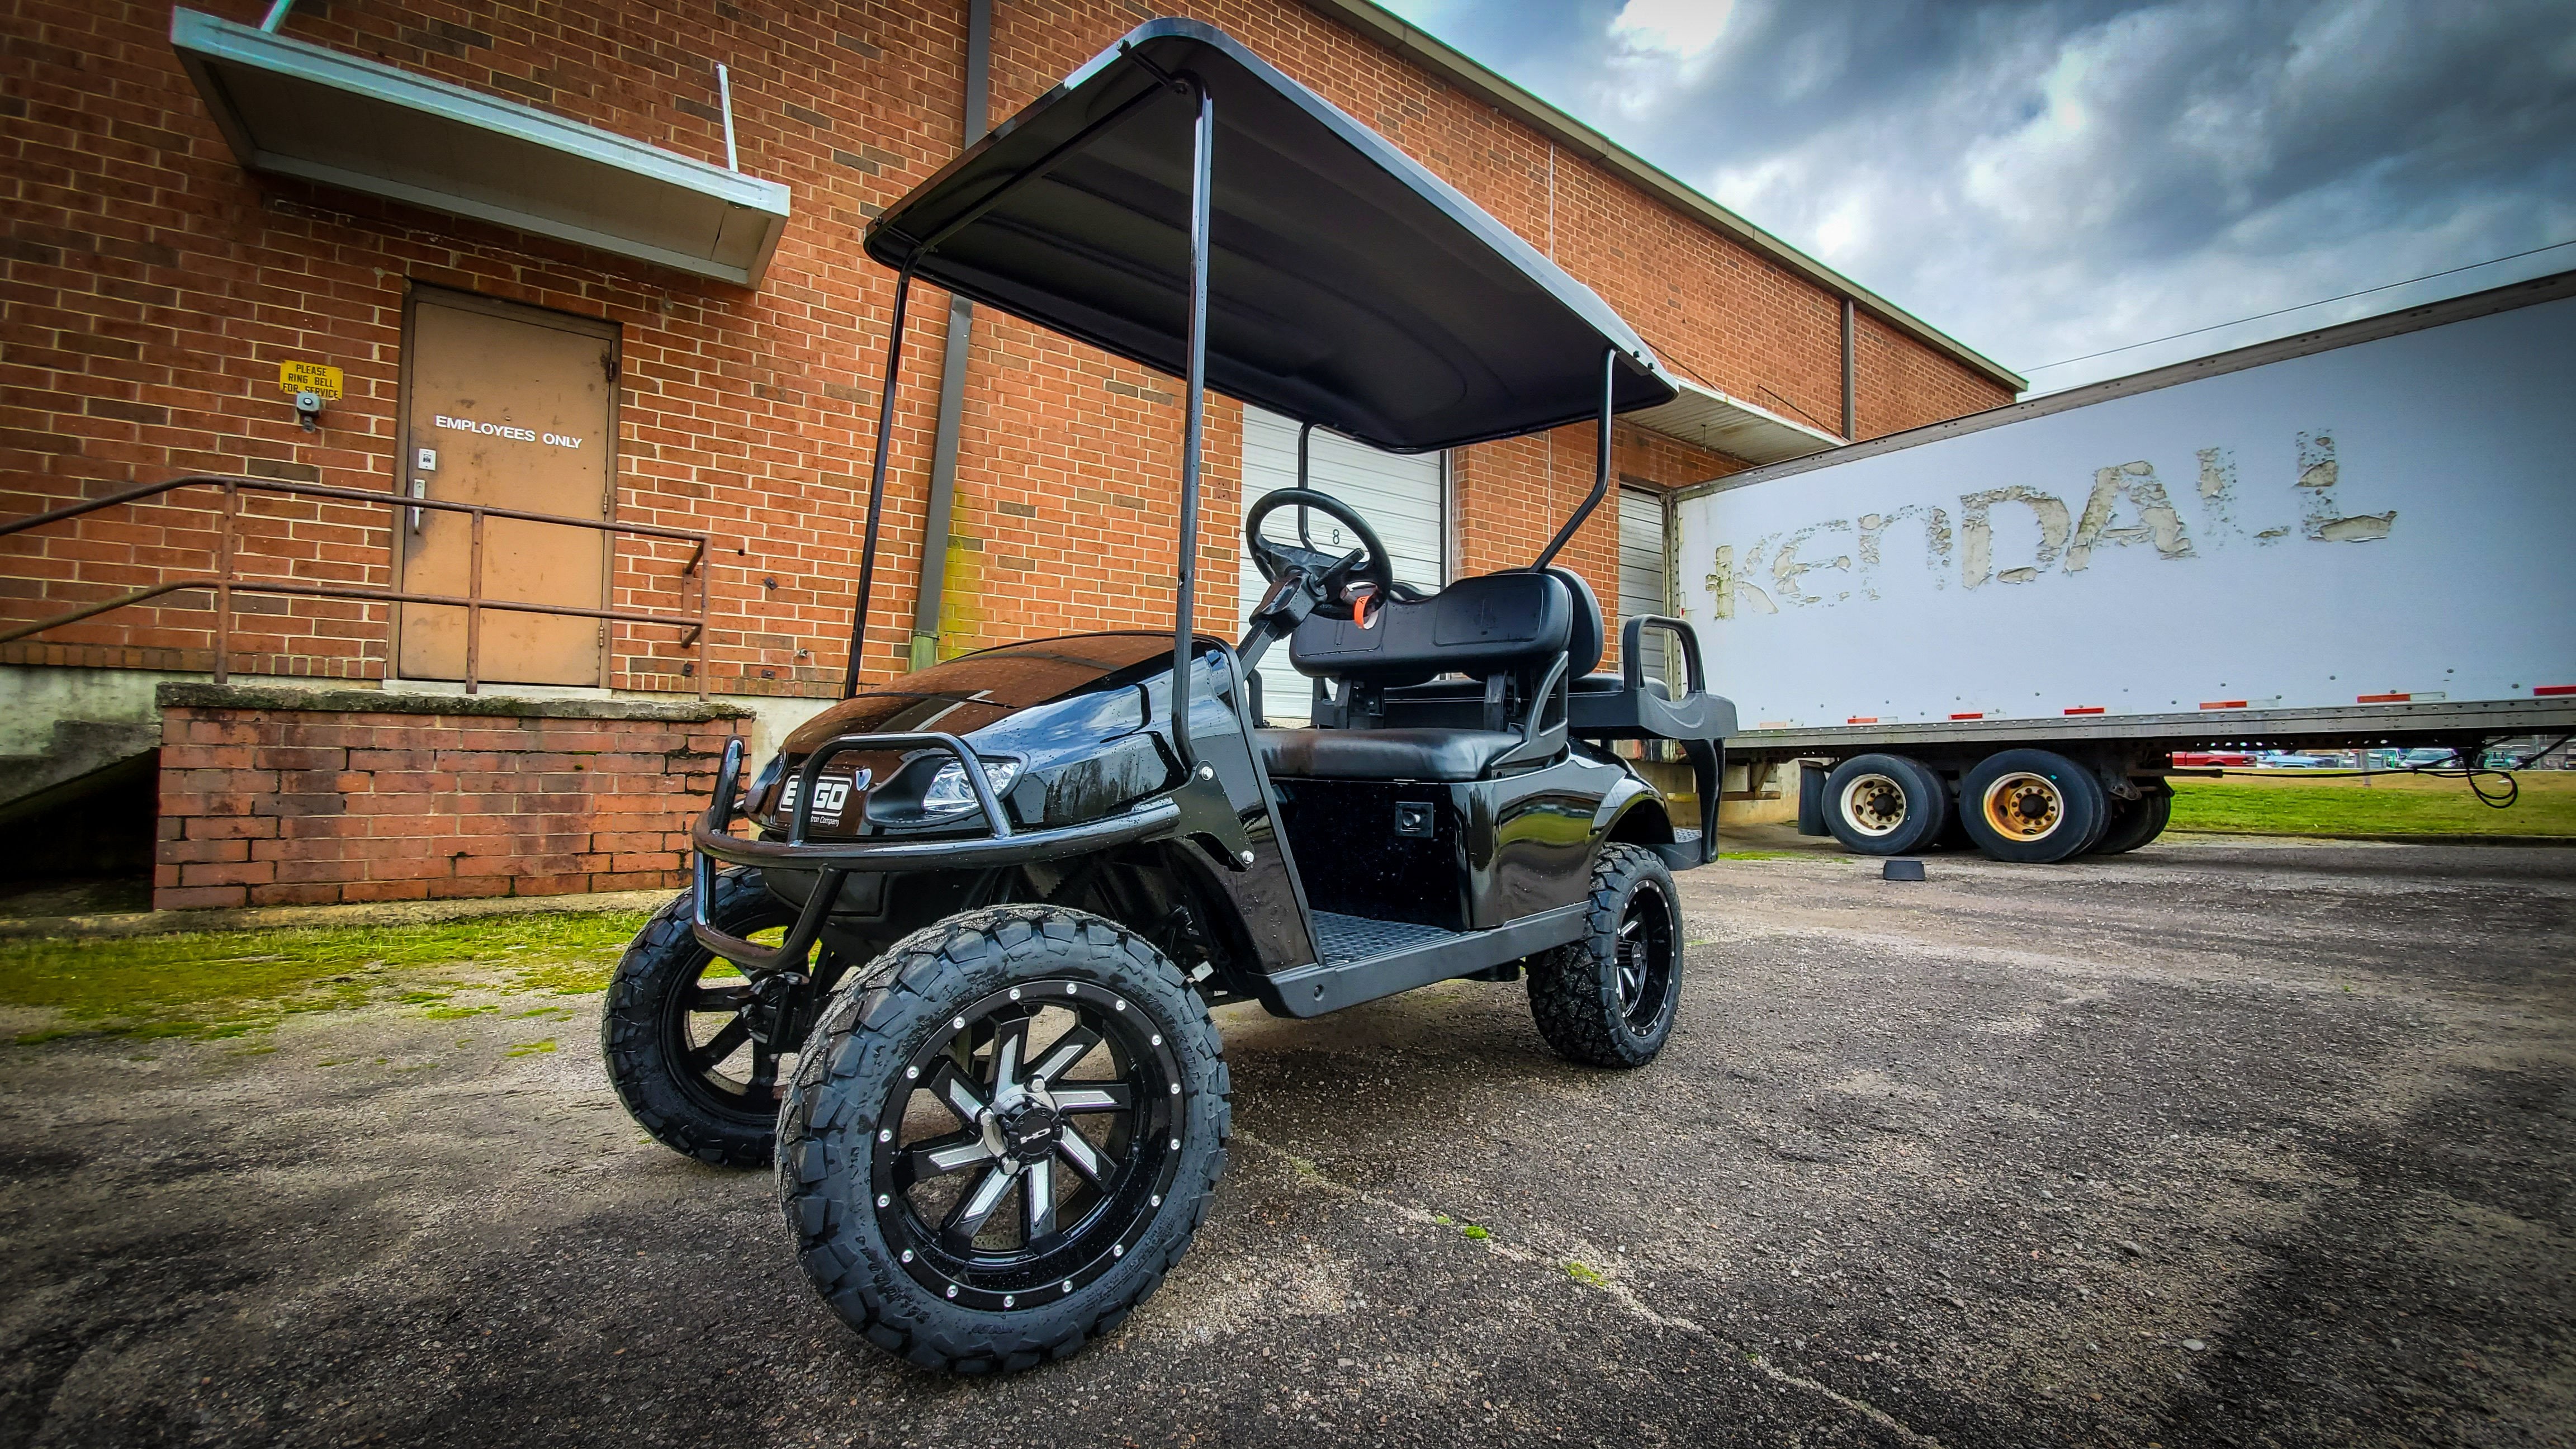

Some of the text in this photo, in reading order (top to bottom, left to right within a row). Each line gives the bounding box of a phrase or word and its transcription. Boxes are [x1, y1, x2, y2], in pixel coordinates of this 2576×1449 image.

[296, 364, 327, 377] PLEASE
[288, 373, 334, 388] RING BELL
[282, 382, 338, 399] FOR SERVICE
[435, 415, 583, 449] EMPLOYEES ONLY
[1333, 528, 1340, 545] 8
[782, 781, 849, 811] EGO
[820, 816, 840, 827] Company
